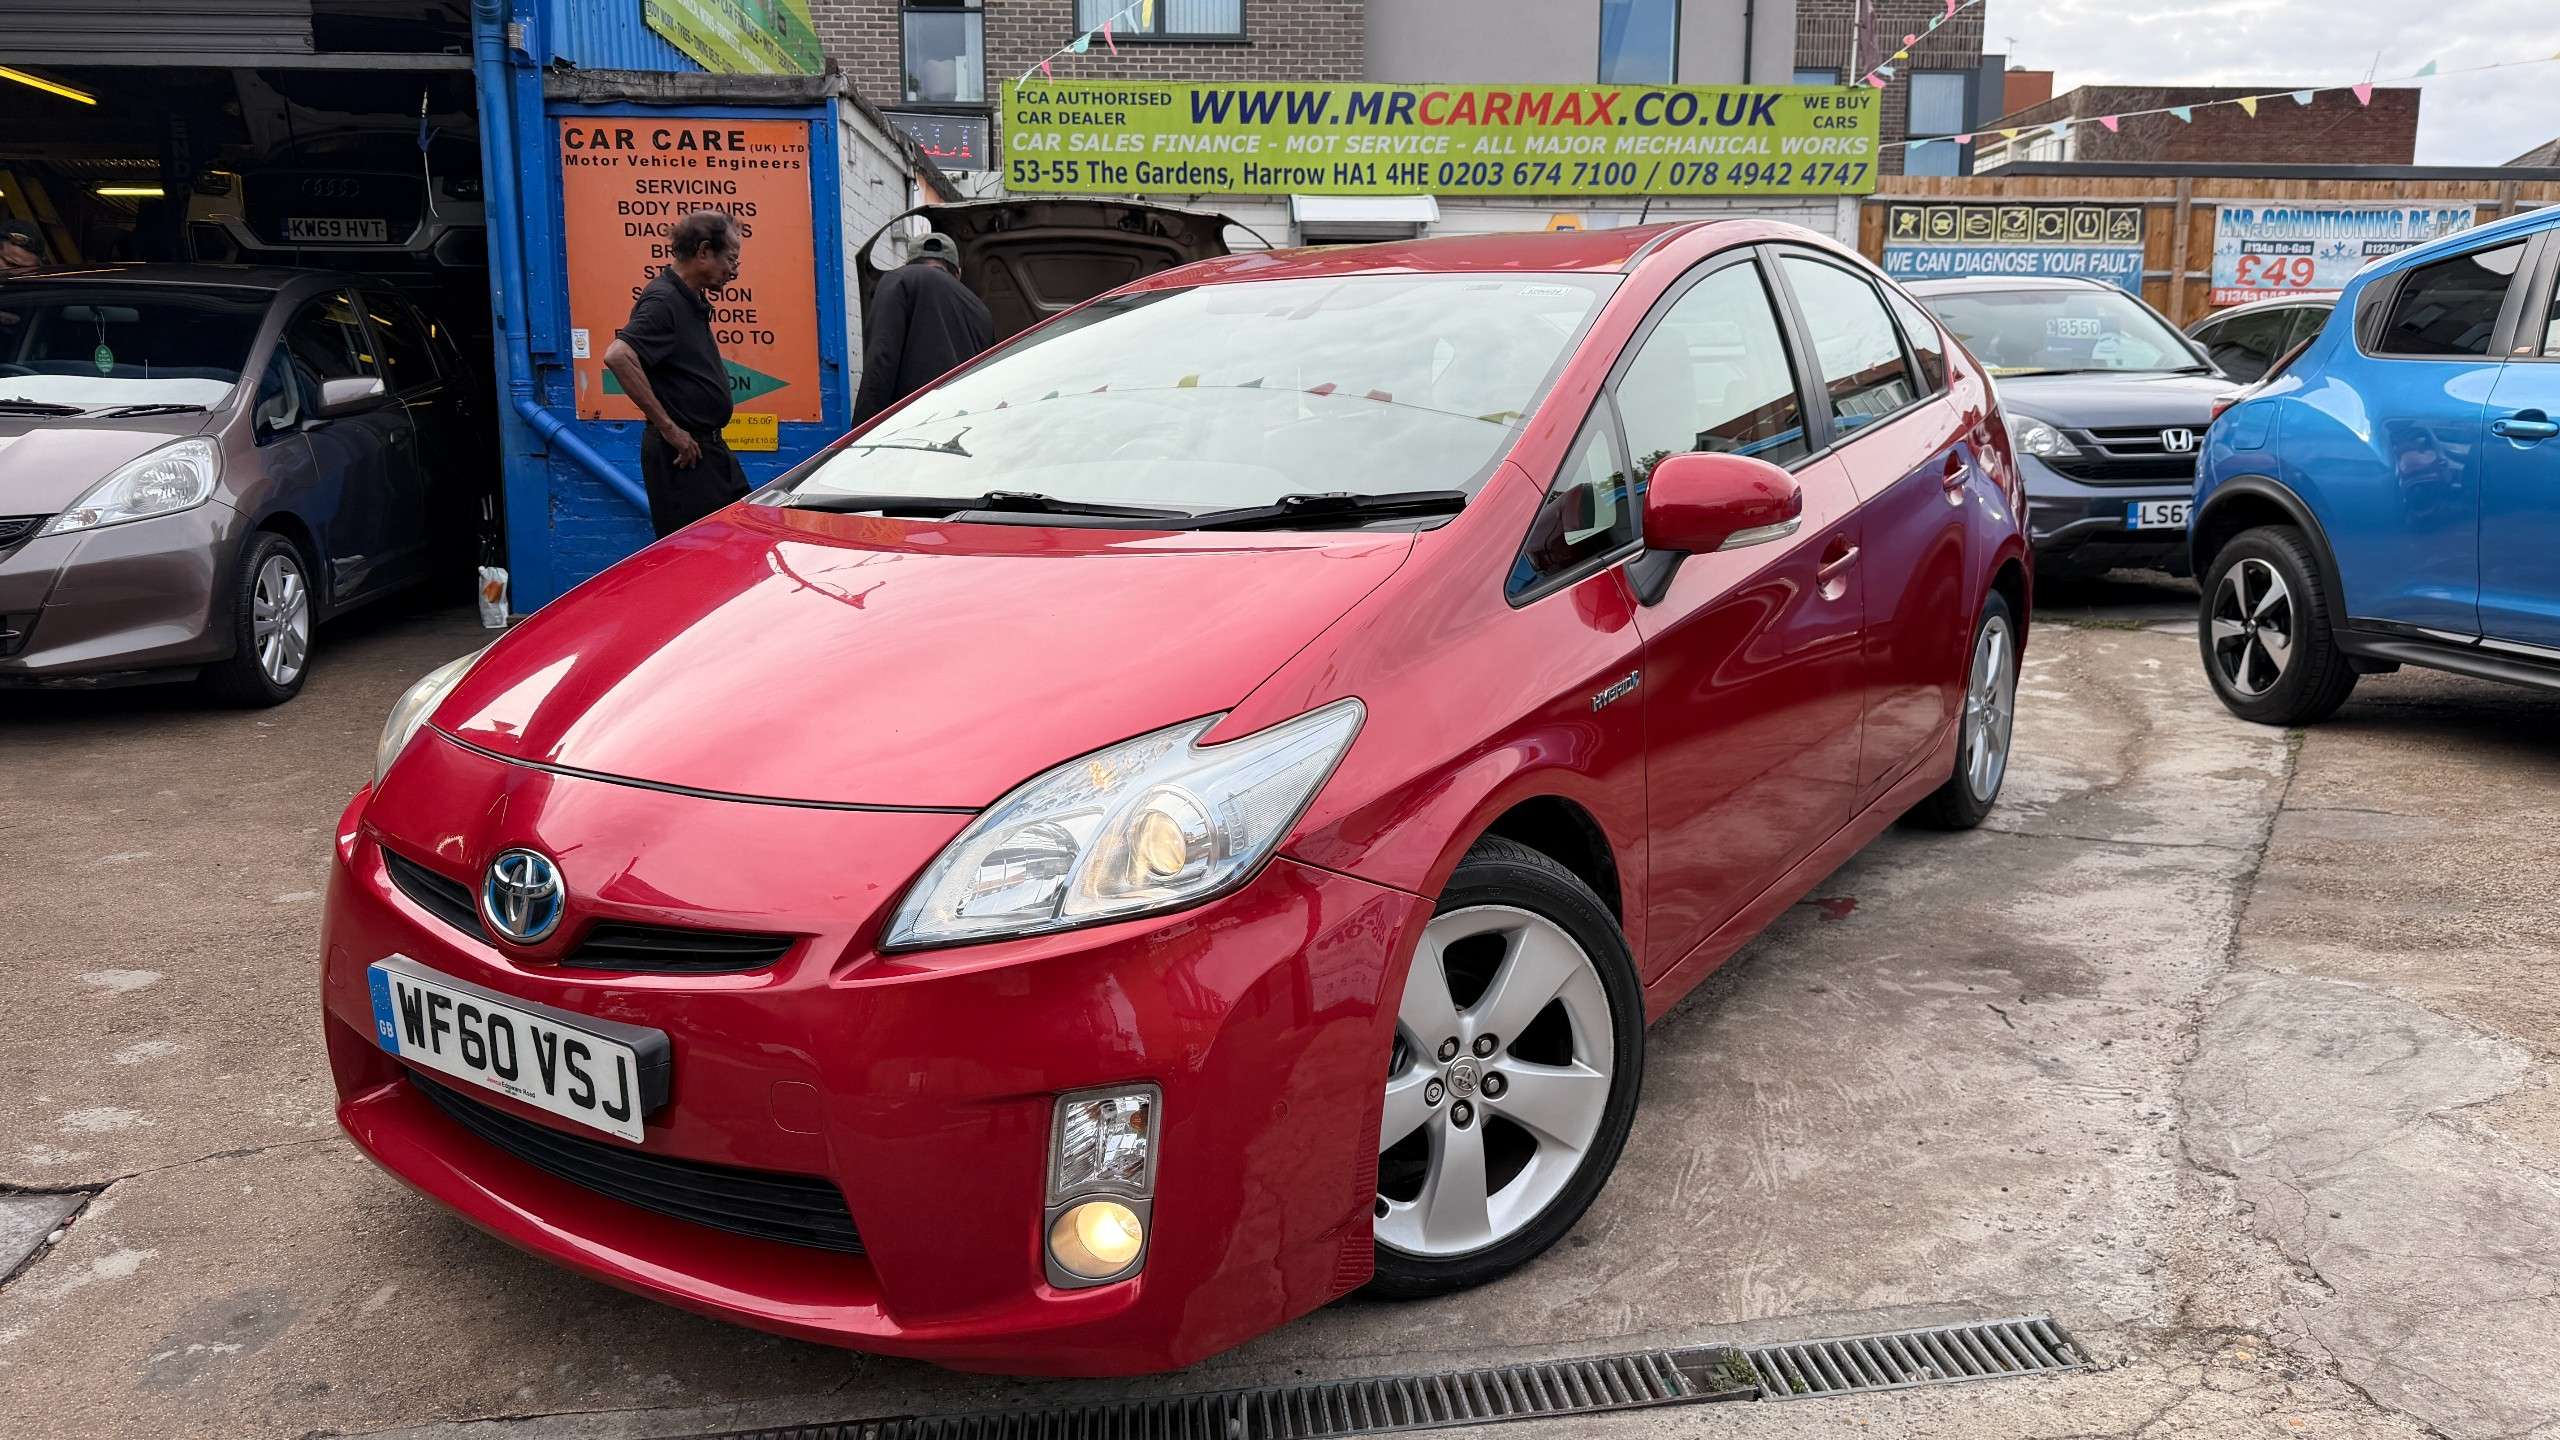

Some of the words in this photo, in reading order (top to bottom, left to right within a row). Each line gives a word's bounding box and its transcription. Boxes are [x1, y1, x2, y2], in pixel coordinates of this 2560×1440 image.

[1017, 91, 1048, 105] FCA
[1056, 91, 1172, 107] AUTHORISED
[1803, 96, 1830, 109] WE
[1836, 96, 1870, 110] BUY
[1190, 89, 1783, 127] WWW.MRCARMAX.CO.UK
[1017, 111, 1055, 125] CAR
[1058, 111, 1126, 126] DEALER
[1813, 115, 1858, 129] CARS
[564, 128, 635, 150] CAR
[652, 129, 746, 151] CARE
[750, 143, 777, 153] (UK)
[782, 144, 805, 153] LTD
[1012, 133, 1065, 152] CAR
[1068, 134, 1144, 153] SALES
[1152, 134, 1260, 153] FINANCE
[1285, 135, 1339, 154] MOT
[1345, 135, 1449, 154] SERVICE
[1472, 136, 1517, 154] ALL
[1524, 136, 1607, 155] MAJOR
[1614, 136, 1772, 155] MECHANICAL
[1781, 136, 1868, 155] WORKS
[565, 154, 618, 167] Motor
[628, 155, 697, 168] Vehicle
[706, 156, 801, 171] Engineers
[1012, 160, 1078, 184] 53-55
[1086, 161, 1127, 184] The
[1136, 160, 1234, 190] Gardens,
[1243, 161, 1324, 186] Harrow
[1333, 162, 1377, 186] HA1
[1386, 162, 1429, 186] 4HE
[1438, 162, 1503, 186] 0203
[1513, 162, 1561, 186] 674
[1571, 162, 1637, 186] 7100
[1644, 161, 1660, 190] /
[1669, 162, 1719, 186] 078
[1727, 162, 1792, 186] 4942
[1800, 162, 1868, 186] 4747
[635, 180, 737, 195] SERVICING
[618, 201, 670, 216] BODY
[292, 220, 341, 238] KW69
[346, 221, 382, 238] HVT
[2219, 208, 2403, 239] AIR-CONDITIONING
[2407, 208, 2471, 239] RE-GAS
[2275, 243, 2312, 254] Re-Gas
[1887, 252, 1911, 272] WE
[1916, 252, 1950, 272] CAN
[1955, 252, 2038, 273] DIAGNOSE
[2043, 253, 2086, 272] YOUR
[2088, 253, 2139, 273] FAULT
[2235, 254, 2315, 288] £49
[717, 331, 744, 344] GO
[750, 331, 775, 345] TO
[379, 1021, 394, 1038] GB
[396, 981, 519, 1082] WF60
[531, 1025, 631, 1123] VSJ
